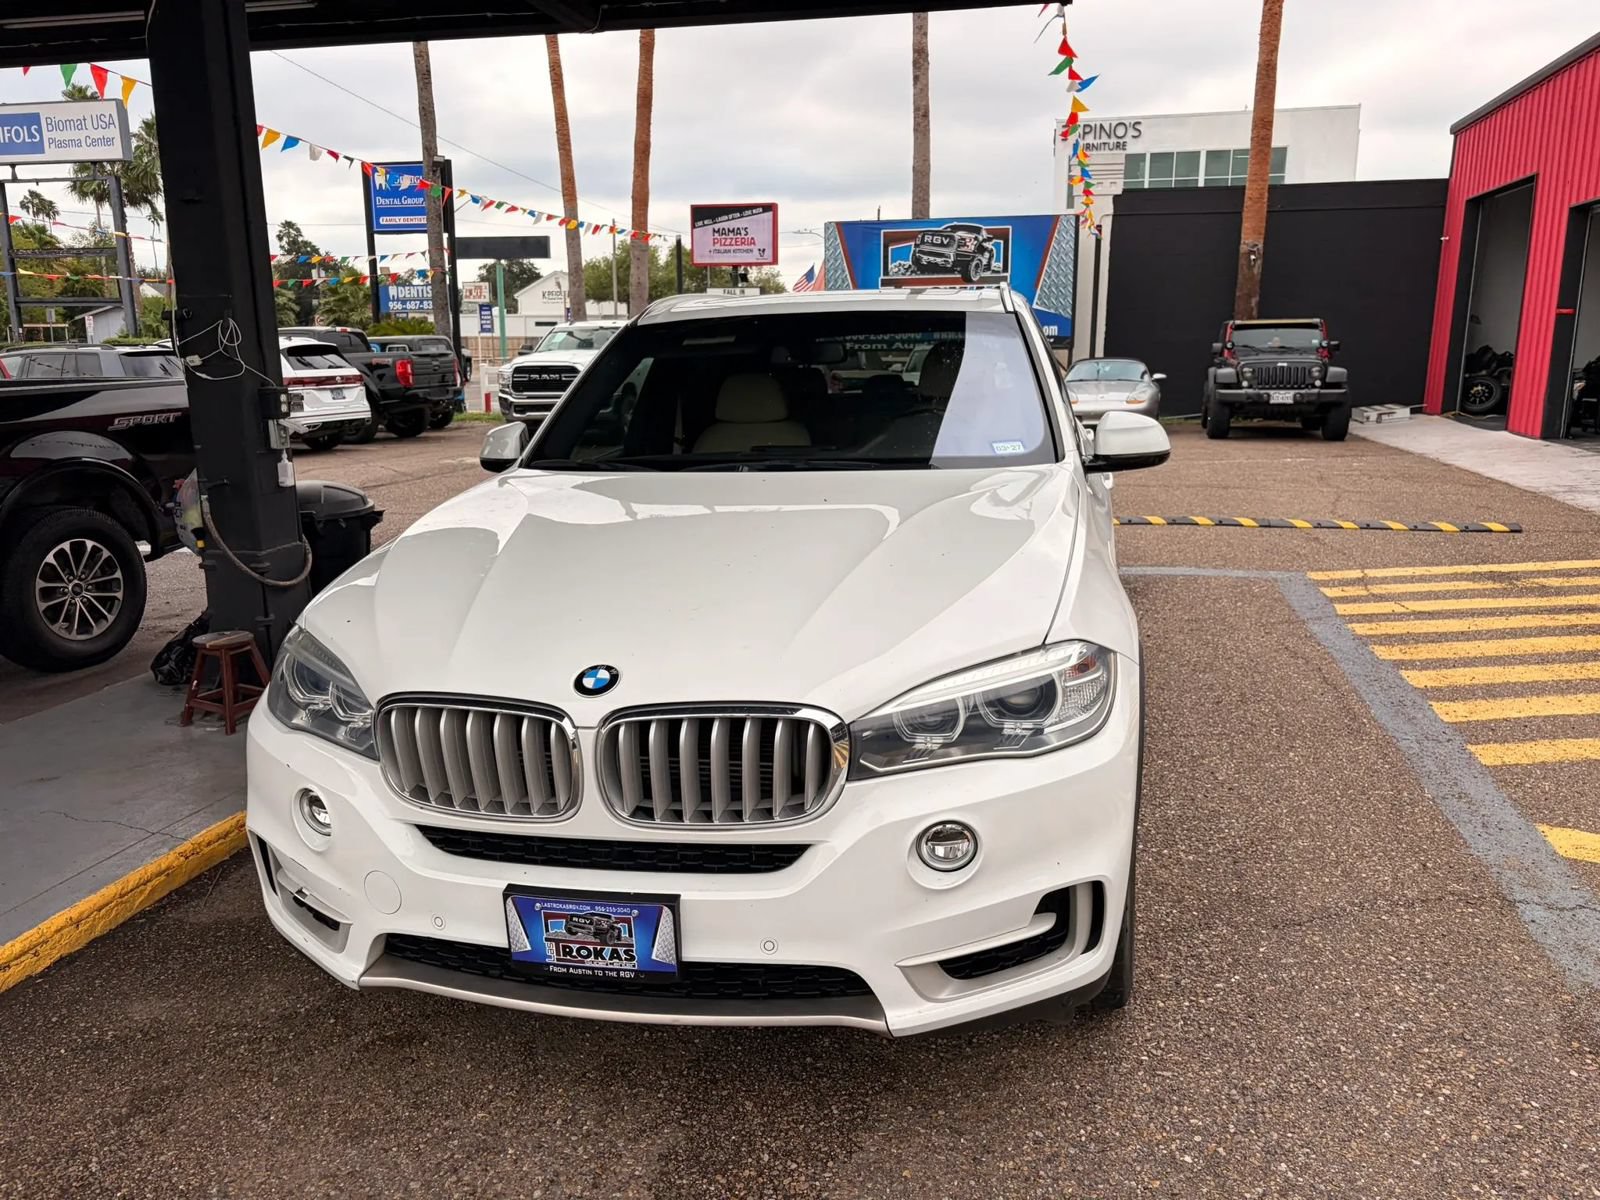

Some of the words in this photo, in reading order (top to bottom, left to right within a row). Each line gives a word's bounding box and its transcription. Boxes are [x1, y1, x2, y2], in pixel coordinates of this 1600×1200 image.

[45, 114, 88, 133] Biomat
[91, 113, 117, 130] USA
[1061, 121, 1142, 141] PINO'S
[48, 137, 83, 149] Plasma
[84, 135, 116, 148] Center
[1081, 141, 1128, 152] RNITURE
[376, 196, 402, 205] DENTAL
[712, 227, 749, 237] MAMA'S
[712, 237, 756, 247] PIZZERIA
[924, 234, 951, 245] RGV
[397, 286, 432, 298] DENTIS
[388, 301, 433, 310] 956-687-83
[107, 412, 182, 431] SPORT
[549, 965, 567, 973] FROM
[568, 967, 593, 976] AUSTIN
[594, 969, 604, 977] TO
